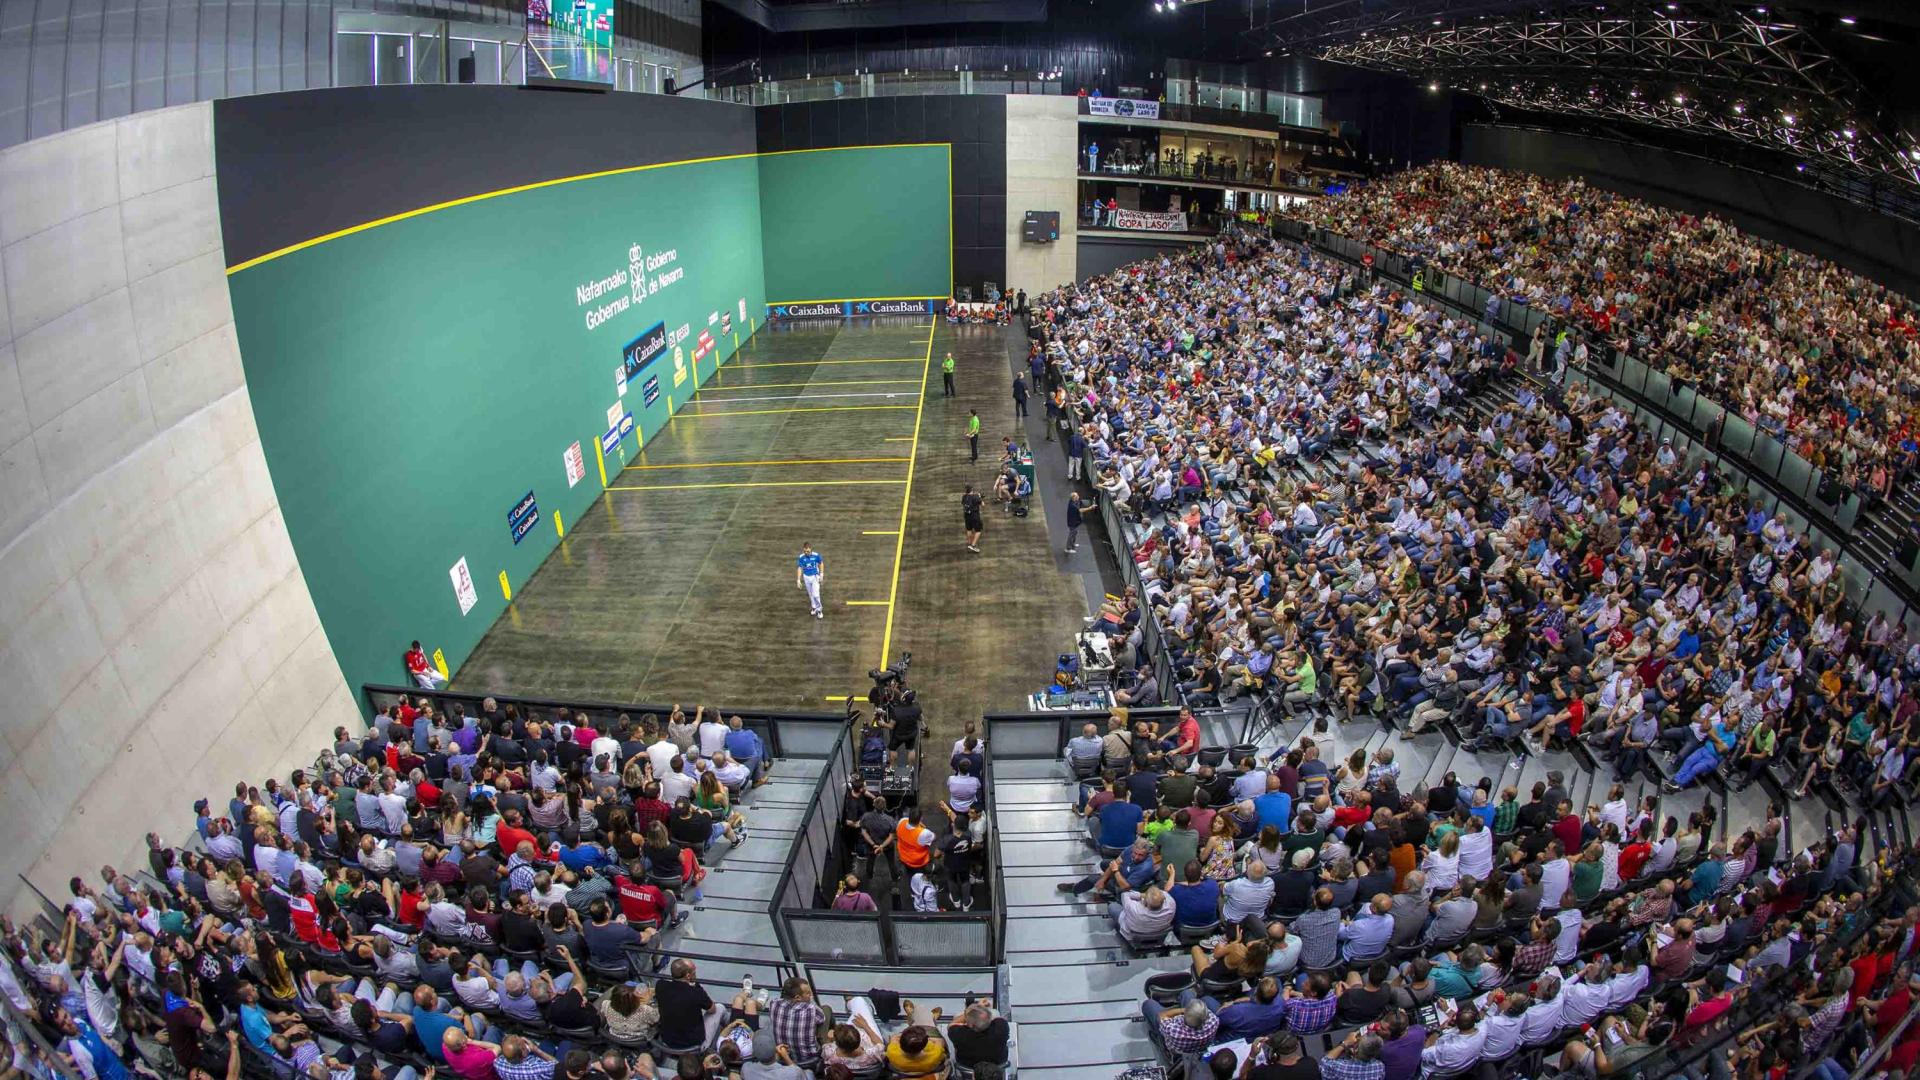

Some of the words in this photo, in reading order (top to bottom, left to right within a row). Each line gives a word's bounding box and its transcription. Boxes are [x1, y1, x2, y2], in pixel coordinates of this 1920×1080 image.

[646, 249, 677, 272] Gobierno
[576, 269, 628, 306] Nafarroako
[648, 278, 658, 295] de
[658, 267, 684, 289] Navarra
[586, 295, 630, 330] Gobernua
[789, 304, 841, 316] CaixaBank
[871, 301, 925, 313] CaixaBank
[635, 331, 666, 364] CaixaBank
